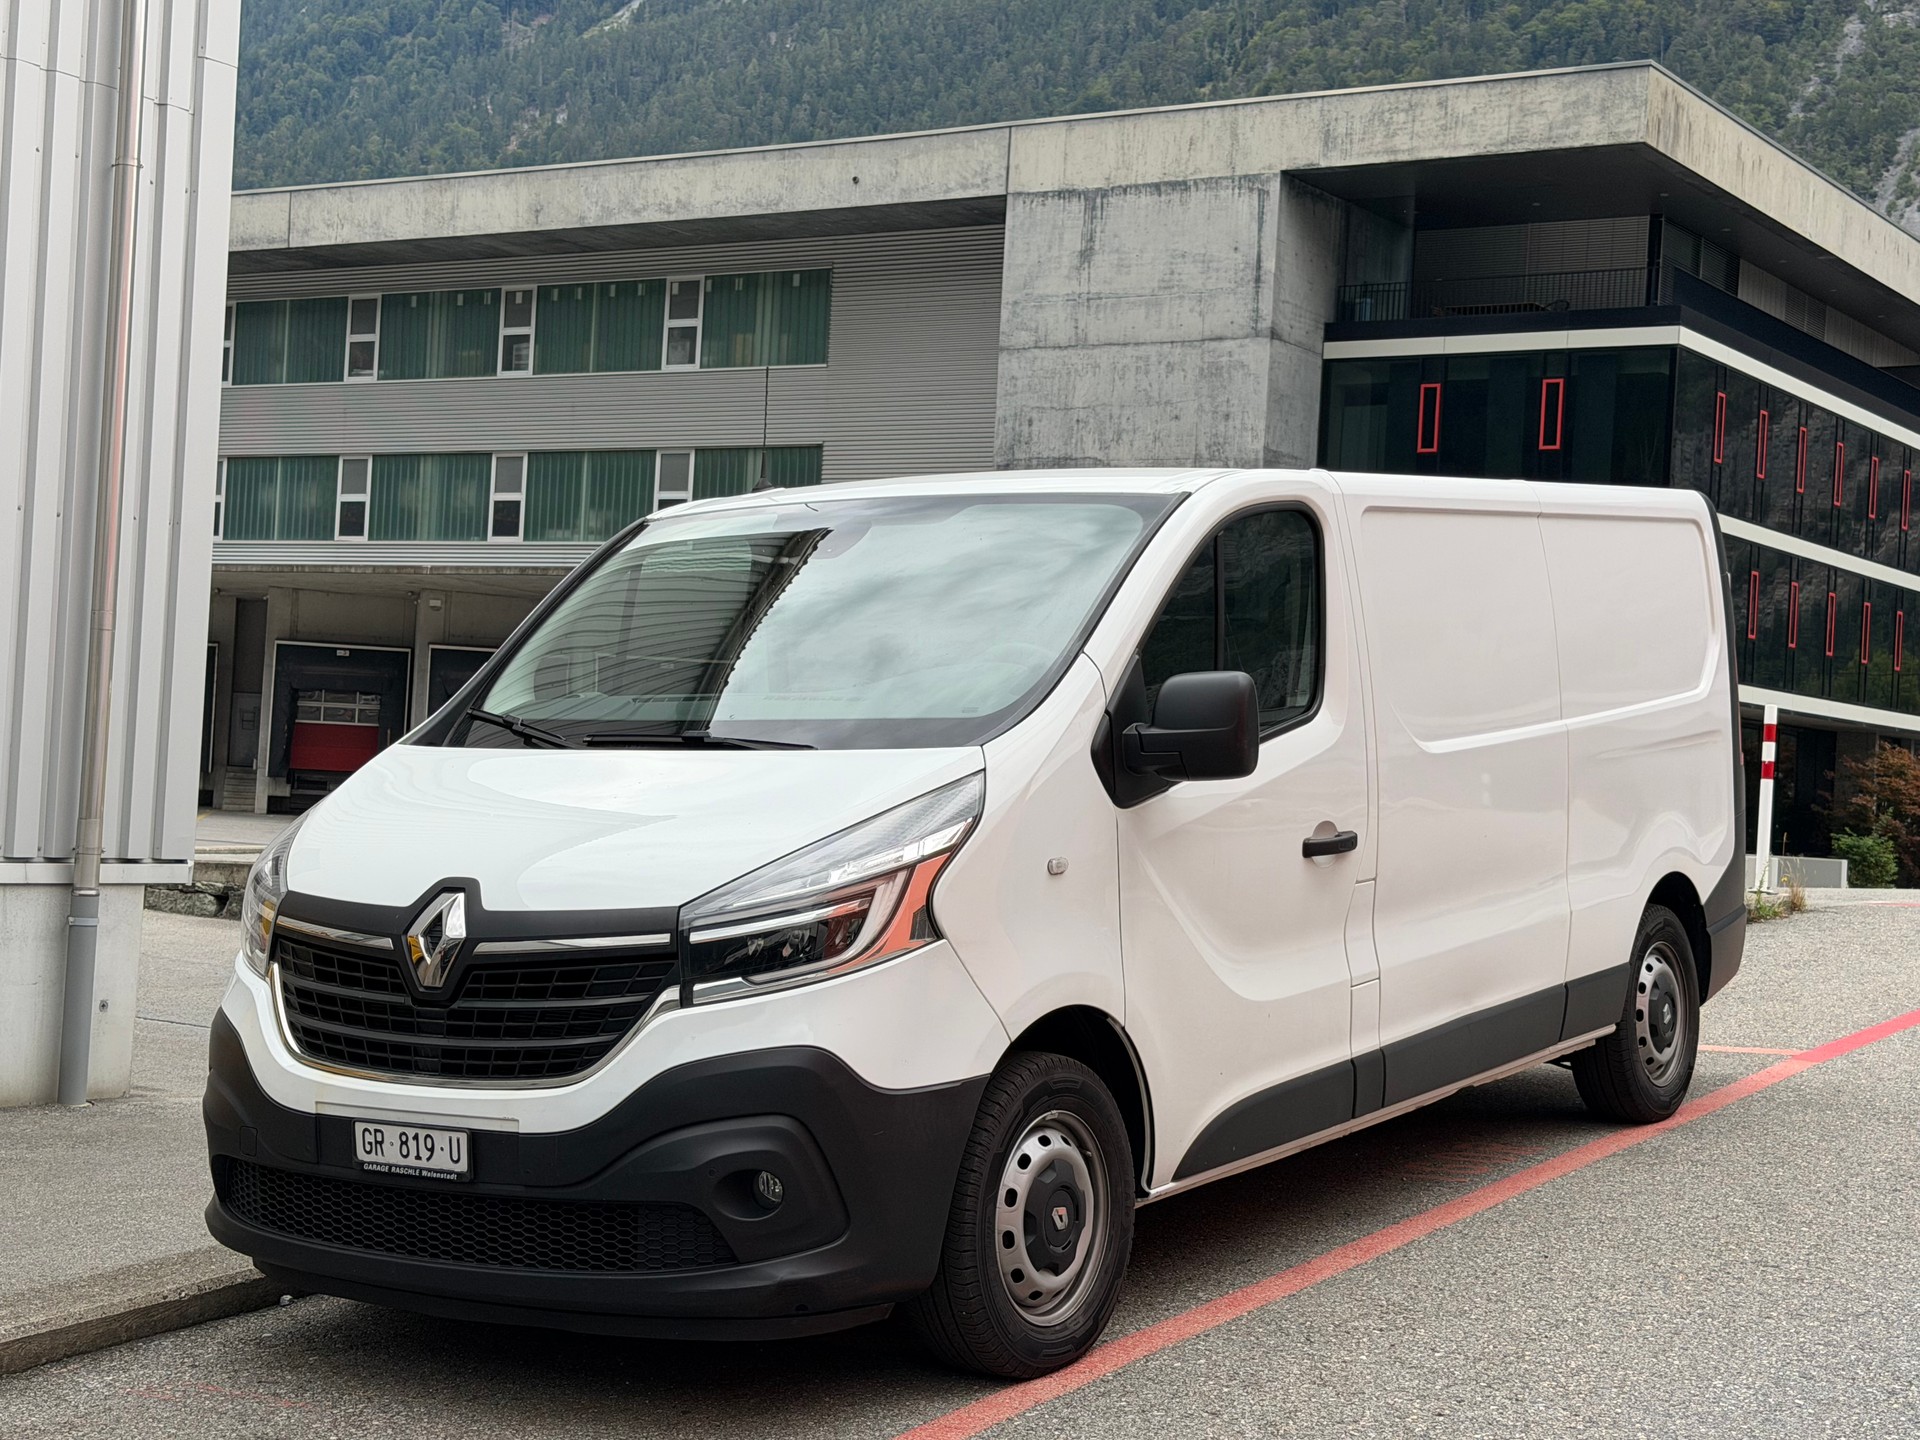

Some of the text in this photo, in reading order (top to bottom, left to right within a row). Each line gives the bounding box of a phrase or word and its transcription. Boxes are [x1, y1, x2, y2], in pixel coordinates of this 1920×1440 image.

[362, 1127, 385, 1157] GR
[363, 1163, 458, 1180] GARAGE RASCHLE Walenstadt
